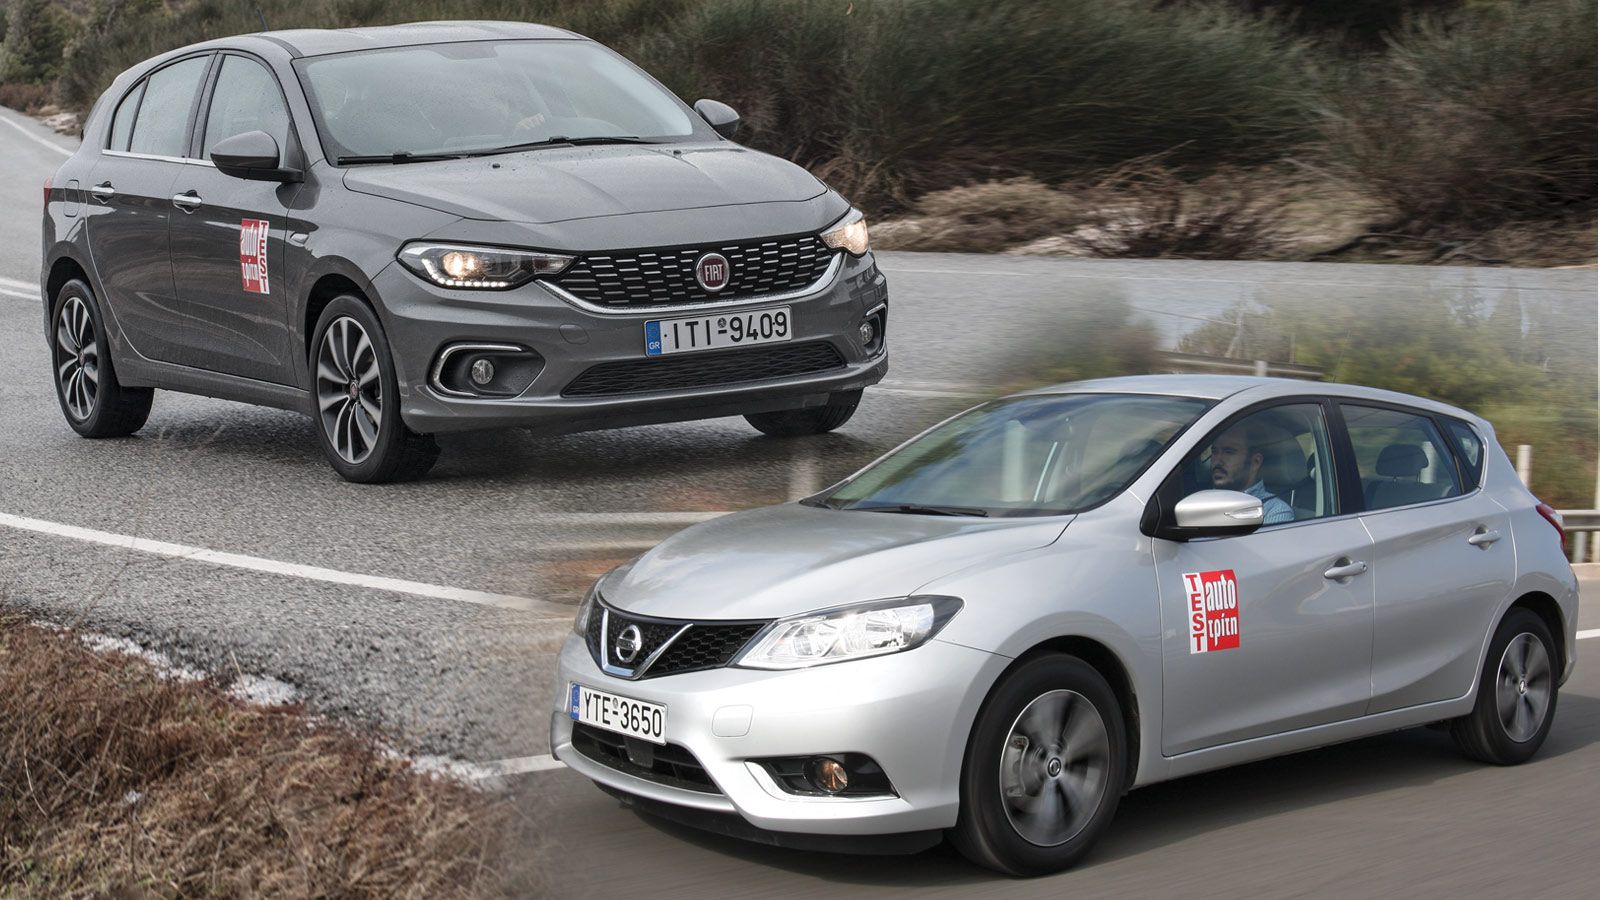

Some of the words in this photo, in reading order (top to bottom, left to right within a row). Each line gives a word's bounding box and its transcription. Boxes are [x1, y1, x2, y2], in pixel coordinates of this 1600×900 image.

[241, 223, 258, 256] auto
[259, 221, 268, 292] TEST
[704, 264, 723, 281] FIAT
[649, 342, 661, 350] GR
[1205, 573, 1236, 612] auto
[1185, 574, 1205, 651] TEST
